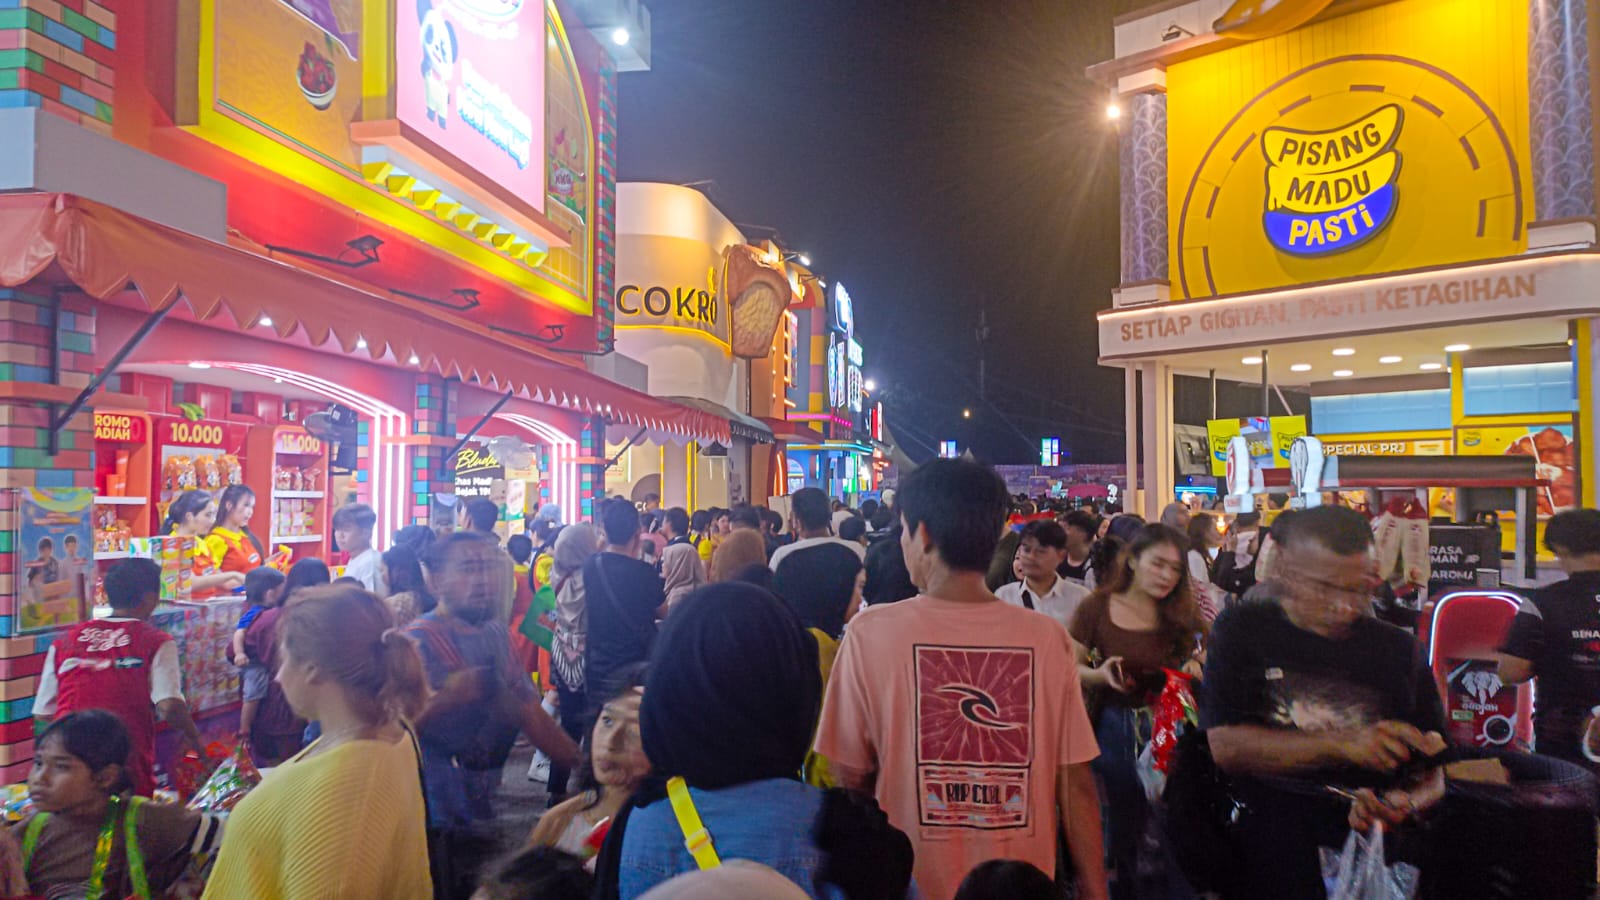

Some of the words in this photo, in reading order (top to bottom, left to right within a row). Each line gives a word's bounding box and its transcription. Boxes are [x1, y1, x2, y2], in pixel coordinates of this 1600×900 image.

[1278, 123, 1381, 166] PISANG
[1286, 170, 1371, 206] MADU
[616, 285, 718, 324] COKRO
[1121, 315, 1192, 342] SETIAP
[1299, 293, 1367, 318] PASTI
[1375, 273, 1536, 312] KETAGIHAN
[95, 415, 130, 428] ROMO
[95, 427, 130, 440] ADIAH
[171, 422, 222, 444] 10.000
[1380, 442, 1406, 454] PRJ
[1572, 630, 1600, 638] BENA
[945, 782, 970, 803] RIP
